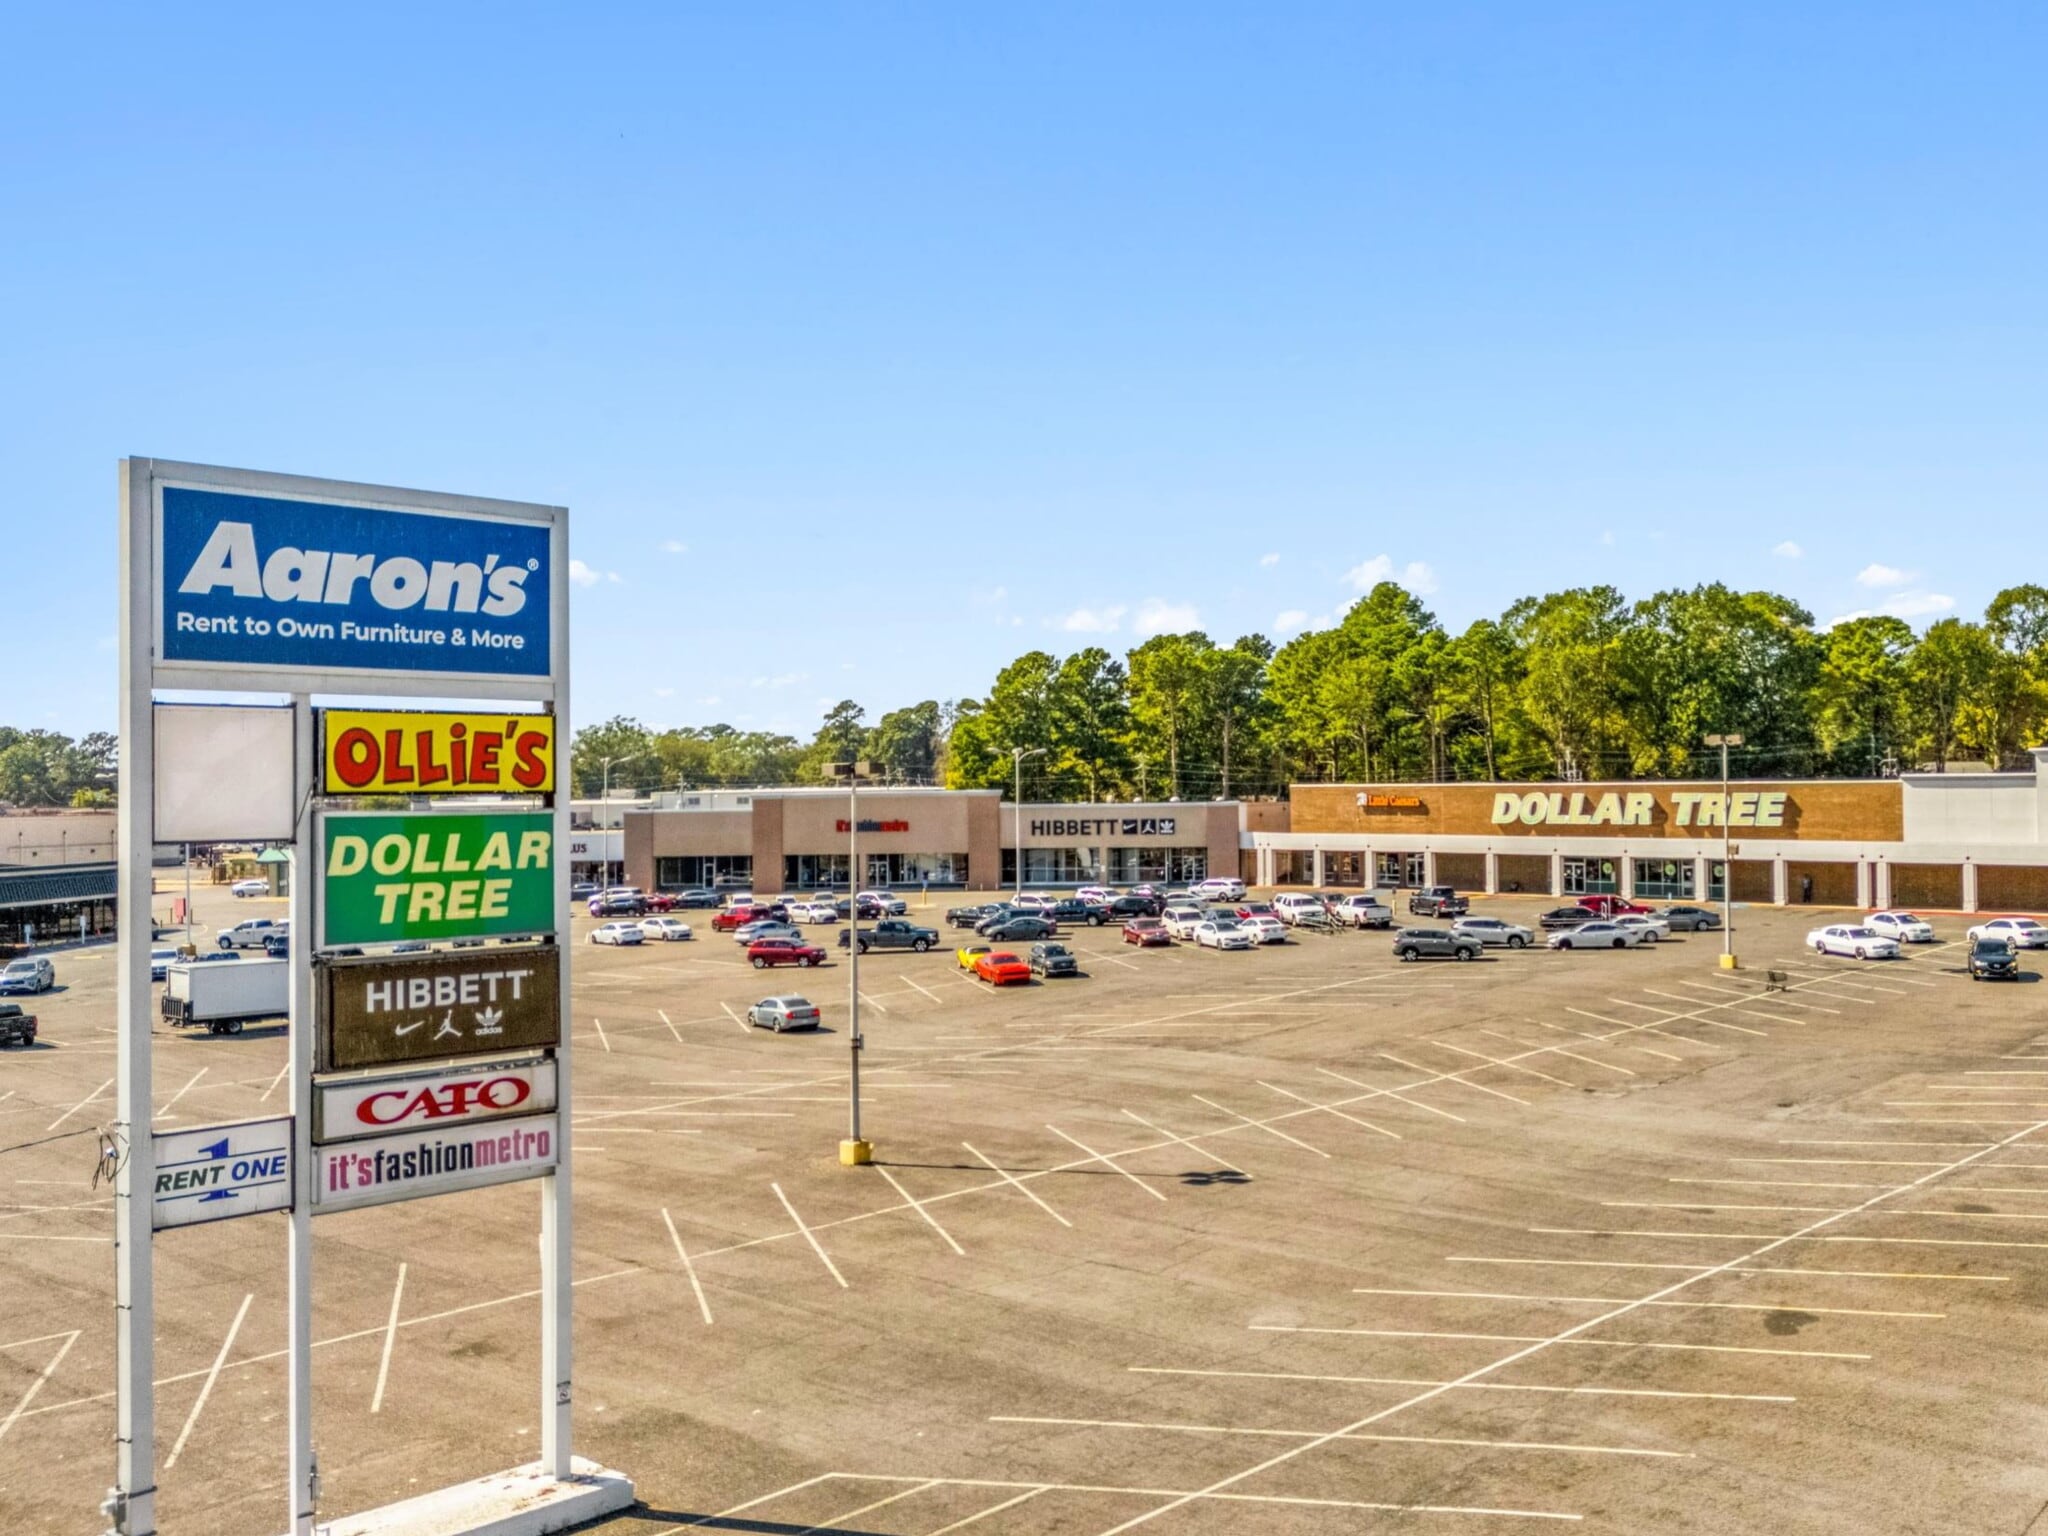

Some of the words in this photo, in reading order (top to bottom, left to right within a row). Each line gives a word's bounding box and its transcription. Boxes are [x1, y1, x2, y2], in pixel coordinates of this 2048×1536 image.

[178, 520, 530, 617] Aaron's
[176, 611, 239, 634] Rent
[244, 616, 272, 636] to
[276, 617, 335, 640] Own
[340, 621, 446, 645] Furniture
[451, 628, 466, 646] &
[471, 629, 525, 650] More
[1031, 819, 1119, 836] HIBBETT
[1491, 792, 1656, 826] DOLLAR
[1671, 792, 1787, 827] TREE
[327, 831, 552, 877] DOLLAR
[373, 878, 513, 925] TREE
[366, 969, 528, 1014] HIBBETT
[356, 1077, 530, 1125] CATO
[154, 1165, 225, 1193] RENT
[231, 1155, 287, 1181] ONE
